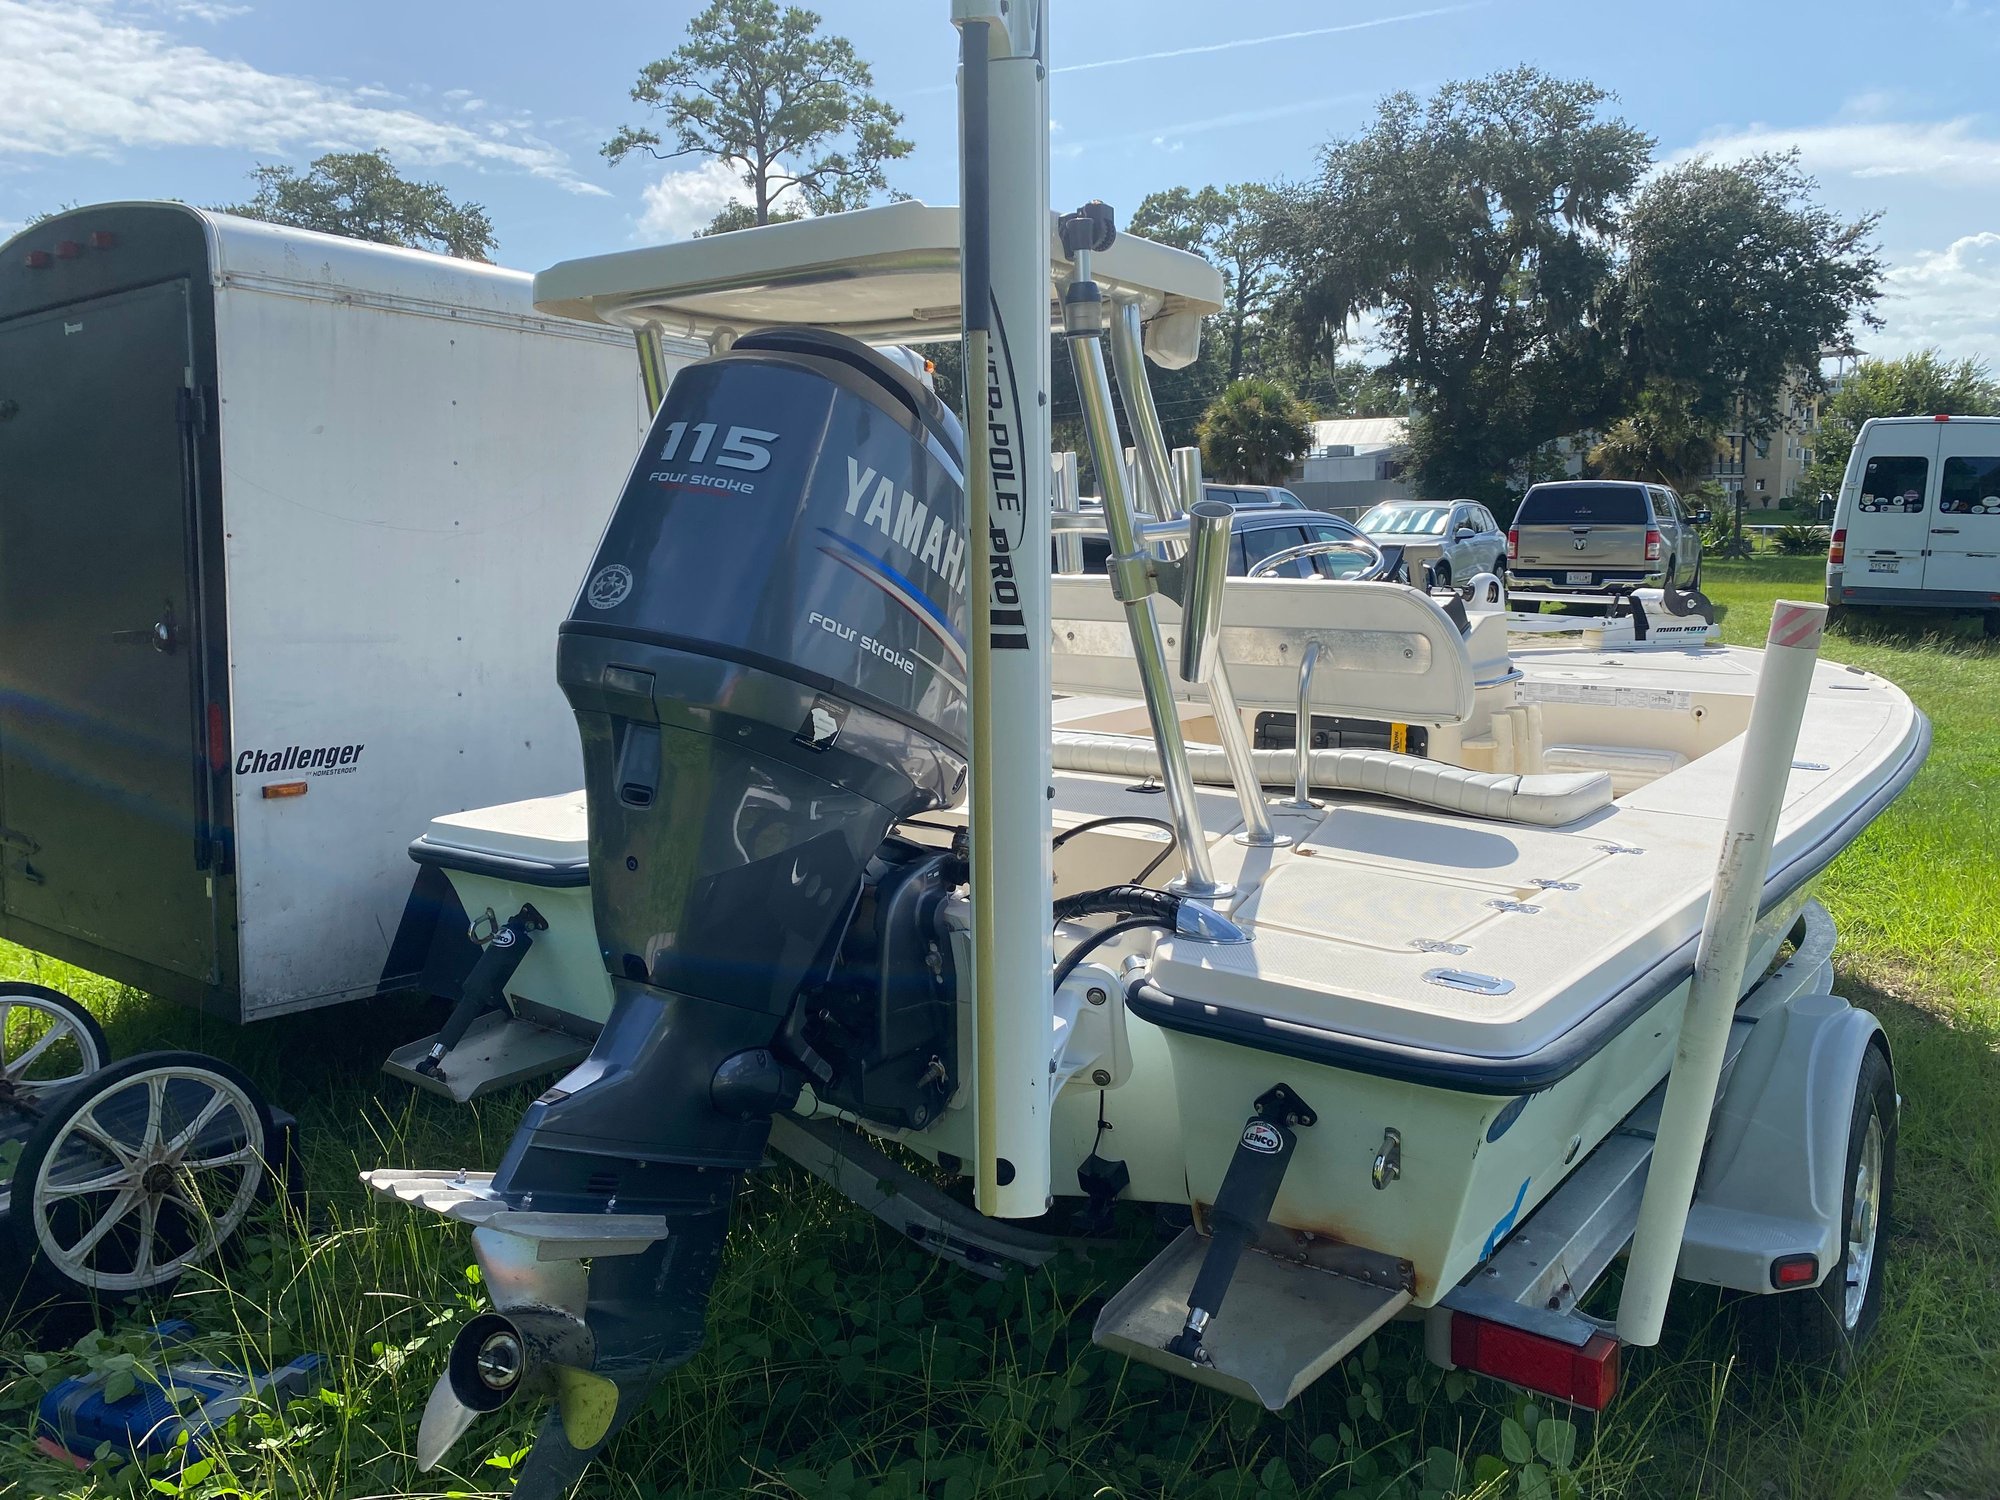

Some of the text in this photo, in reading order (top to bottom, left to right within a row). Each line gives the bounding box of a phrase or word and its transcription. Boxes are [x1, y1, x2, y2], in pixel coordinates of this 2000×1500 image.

[660, 421, 780, 471] 115
[987, 330, 1021, 512] ER-POLE
[990, 528, 1020, 605] PRO
[235, 744, 365, 775] Challenger
[1244, 1132, 1274, 1147] LENCO
